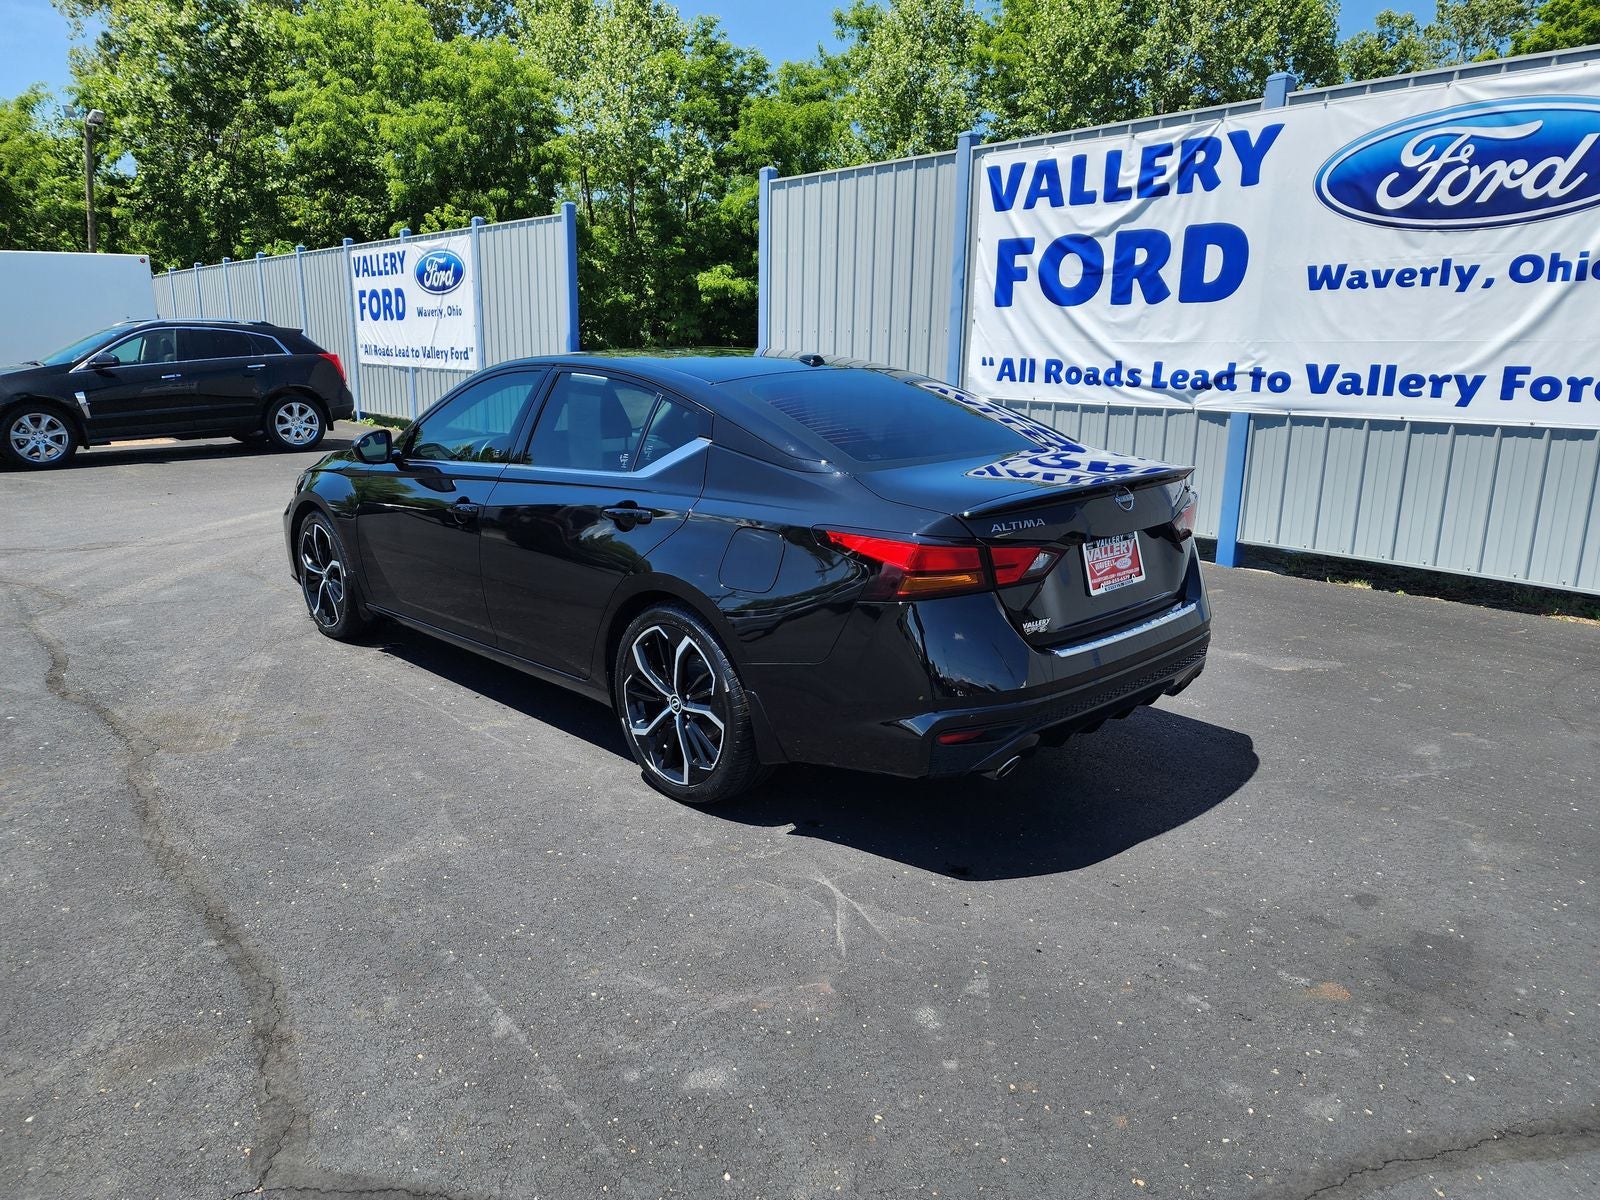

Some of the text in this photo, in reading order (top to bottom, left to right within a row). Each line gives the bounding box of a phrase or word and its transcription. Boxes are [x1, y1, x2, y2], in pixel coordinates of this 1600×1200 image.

[986, 123, 1285, 213] VALLERY
[1376, 119, 1600, 206] Ford
[353, 250, 406, 278] VALLERY
[424, 257, 455, 287] Ford
[994, 222, 1250, 308] FORD
[1307, 258, 1495, 293] Waverly,
[358, 287, 406, 321] FORD
[417, 305, 462, 319] Waverly, Ohio
[374, 345, 393, 357] Roads
[394, 345, 410, 358] Lead
[411, 347, 420, 358] to
[421, 346, 449, 362] Vallery
[1044, 358, 1142, 388] Roads
[1151, 361, 1238, 392] Lead
[1248, 366, 1292, 394] to
[1305, 363, 1487, 408] Vallery
[1499, 366, 1600, 403] For
[991, 518, 1046, 533] ALTIMA
[1086, 538, 1136, 562] VALLERY
[1096, 535, 1124, 548] VALLERY
[1022, 617, 1051, 629] VALLERY
